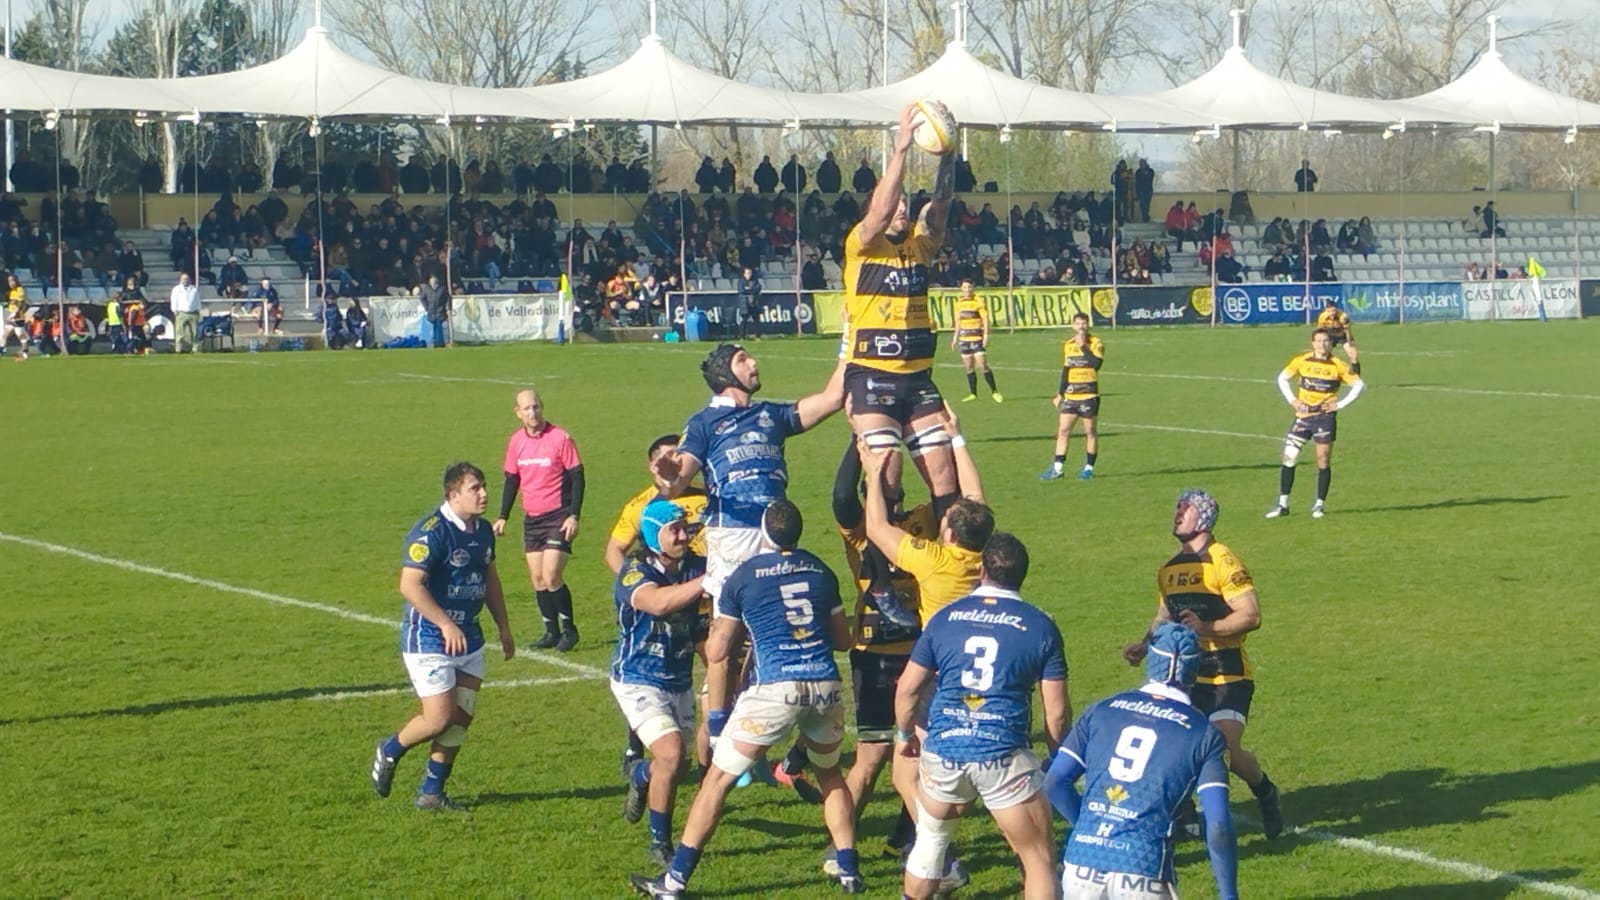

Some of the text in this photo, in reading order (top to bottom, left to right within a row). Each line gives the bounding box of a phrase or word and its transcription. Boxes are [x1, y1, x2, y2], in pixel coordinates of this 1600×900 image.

[488, 307, 501, 318] de
[1227, 297, 1249, 312] BE
[1257, 295, 1340, 312] BE BEAUTY
[780, 581, 814, 626] 5
[948, 609, 1023, 630] meléndez
[961, 635, 999, 692] 3
[1108, 699, 1190, 729] meléndez
[1108, 724, 1158, 783] 9
